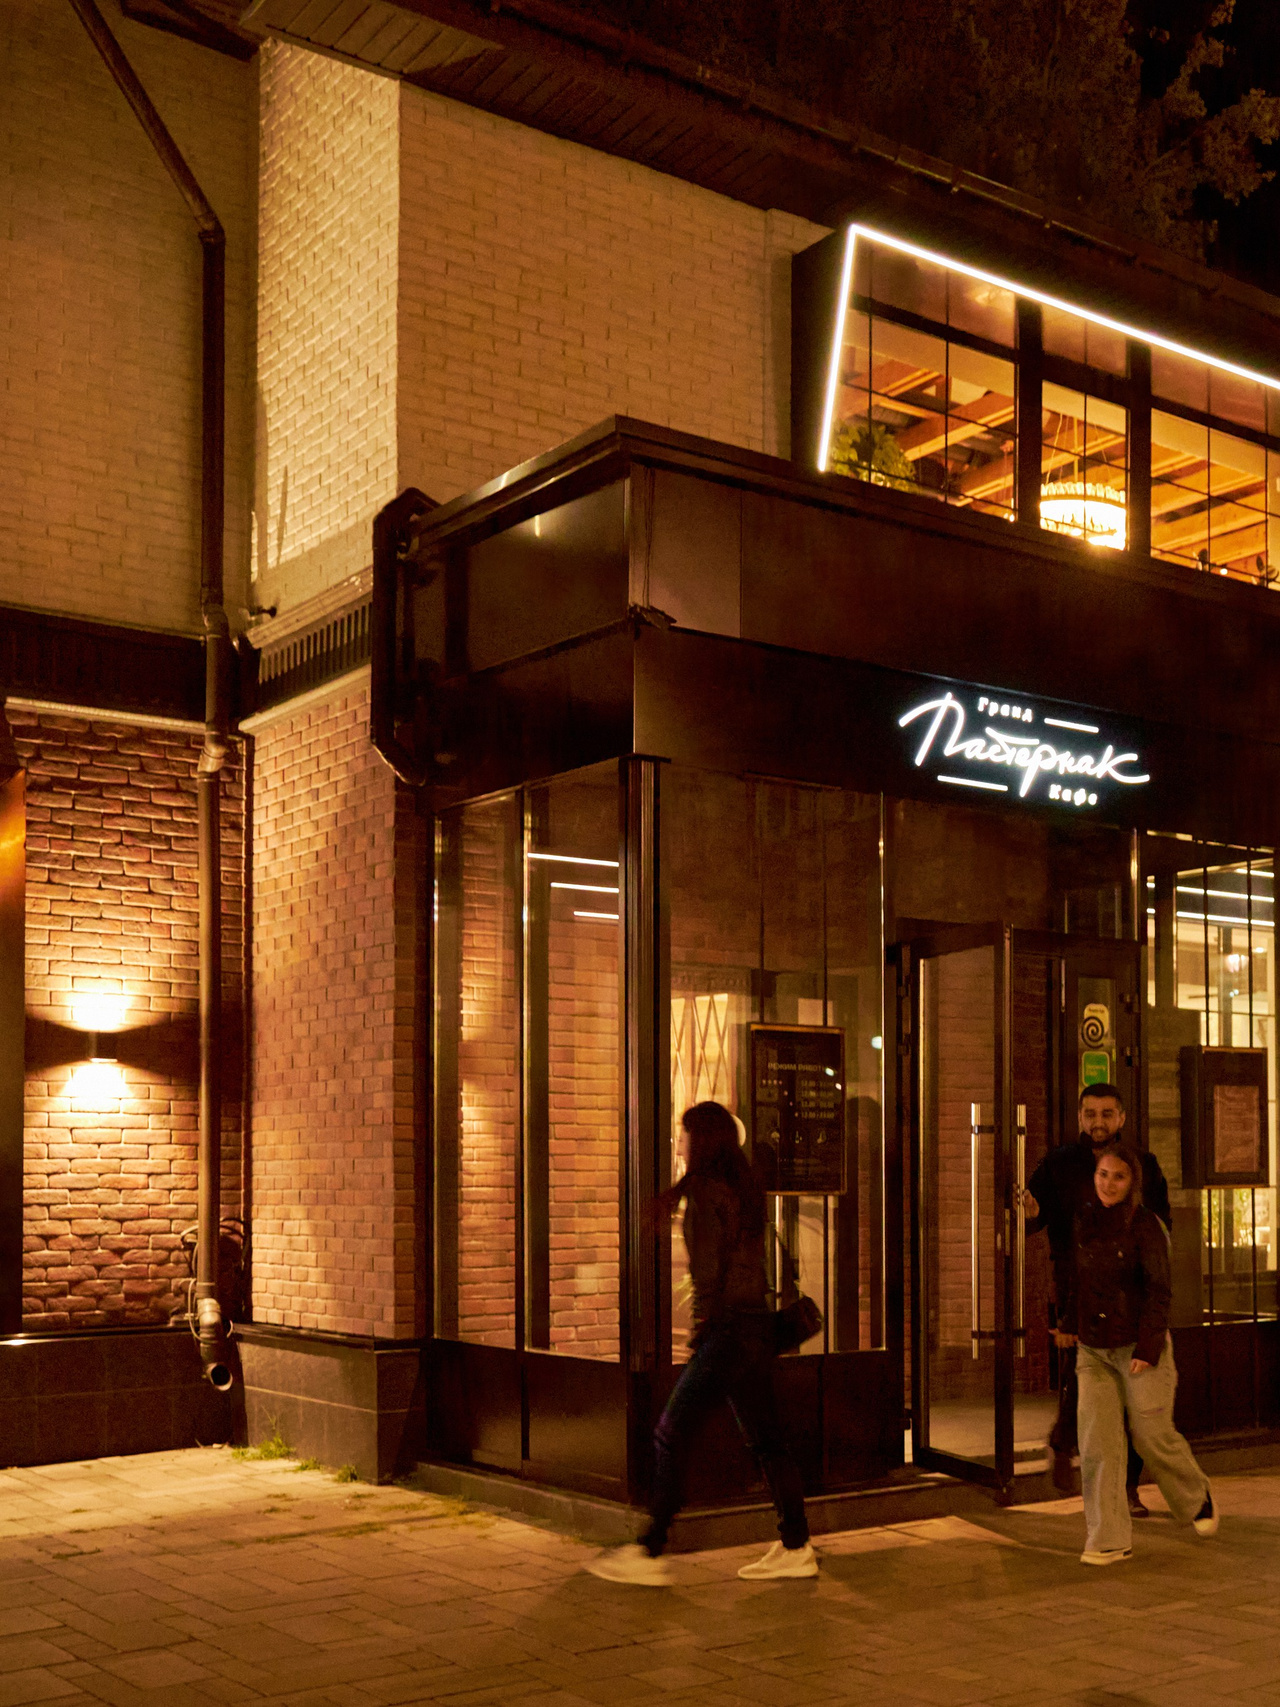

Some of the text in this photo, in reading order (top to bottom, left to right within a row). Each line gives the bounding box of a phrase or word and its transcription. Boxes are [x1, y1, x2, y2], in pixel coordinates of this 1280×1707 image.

[977, 696, 1033, 723] Гранд
[898, 691, 1151, 798] Пастернак
[1048, 783, 1098, 807] Кафе
